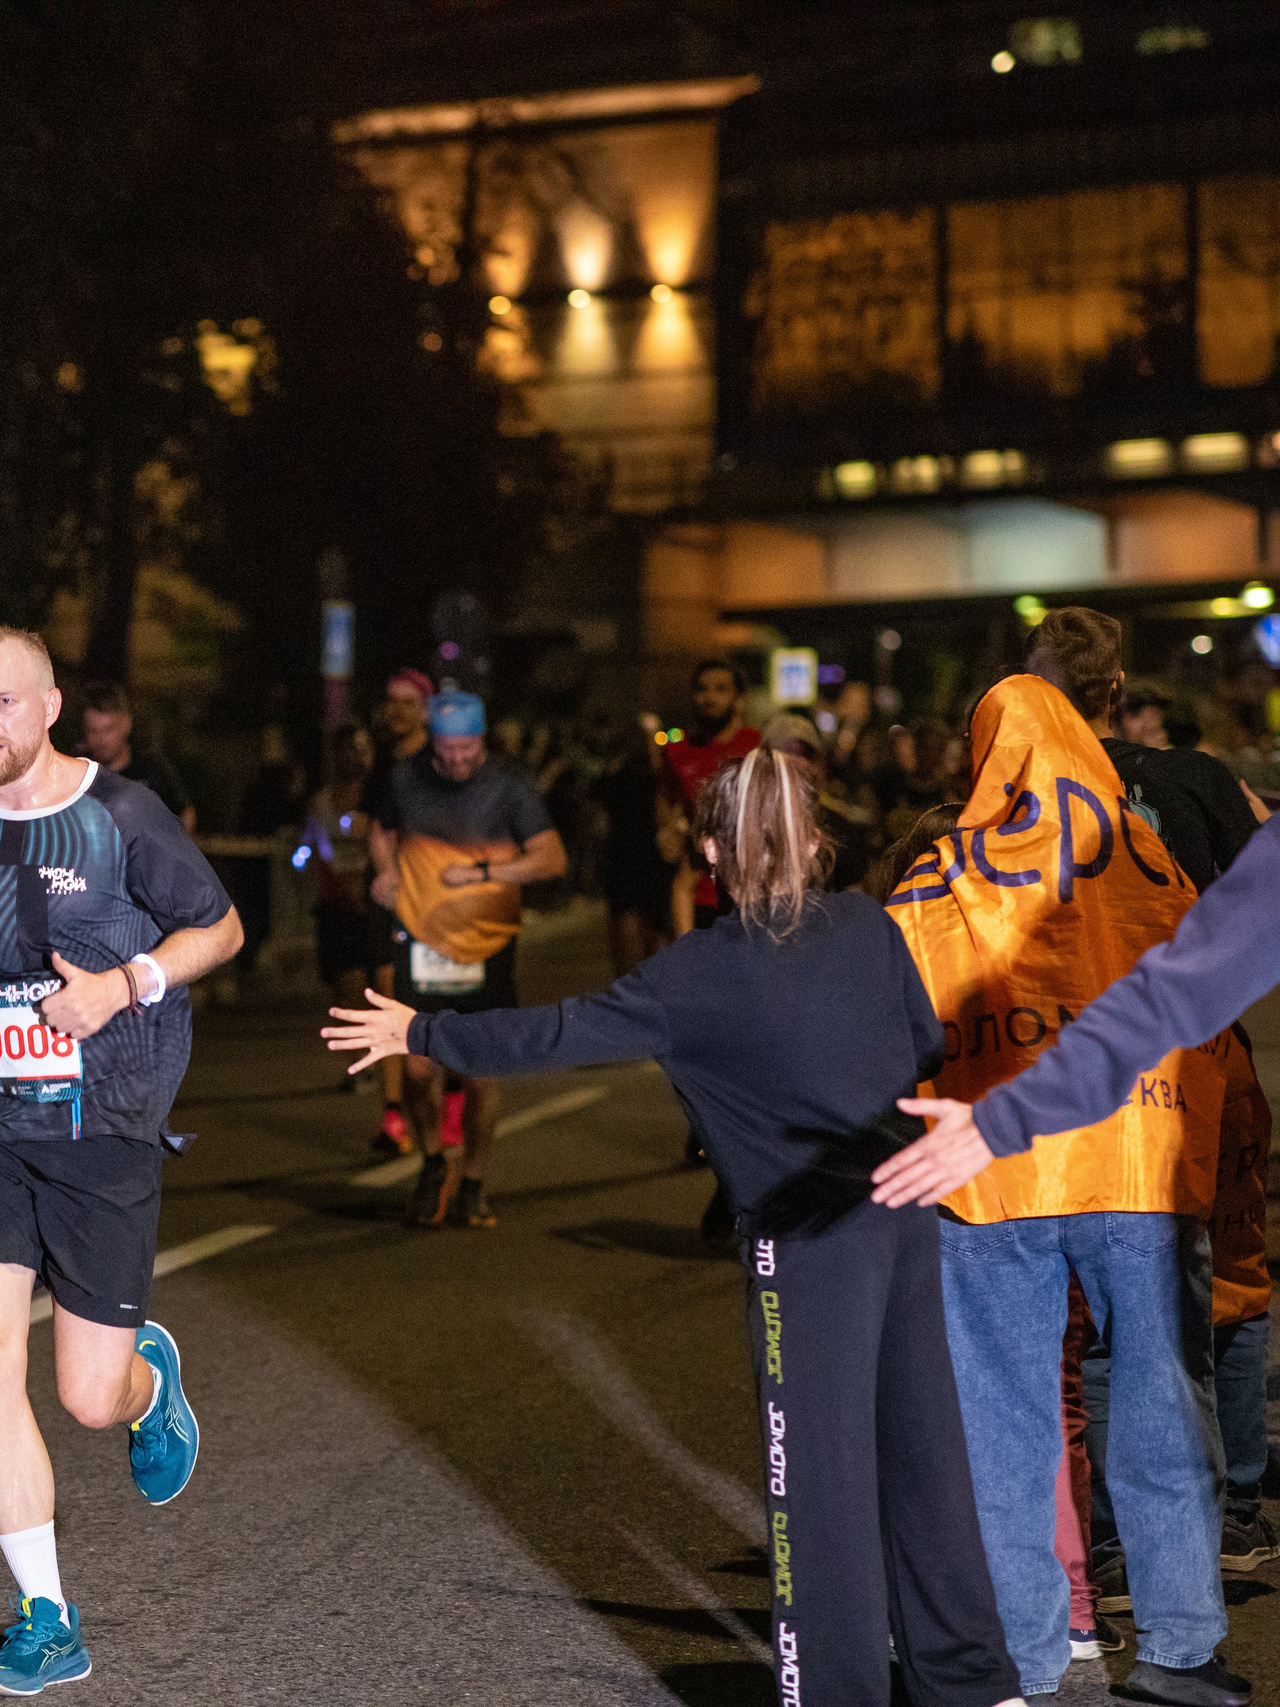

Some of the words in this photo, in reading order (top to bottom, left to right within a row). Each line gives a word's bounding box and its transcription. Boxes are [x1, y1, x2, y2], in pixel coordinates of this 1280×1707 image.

[760, 1290, 784, 1385] JOMOTO
[767, 1401, 786, 1497] JOMOTO
[772, 1511, 793, 1606] JOMOTO
